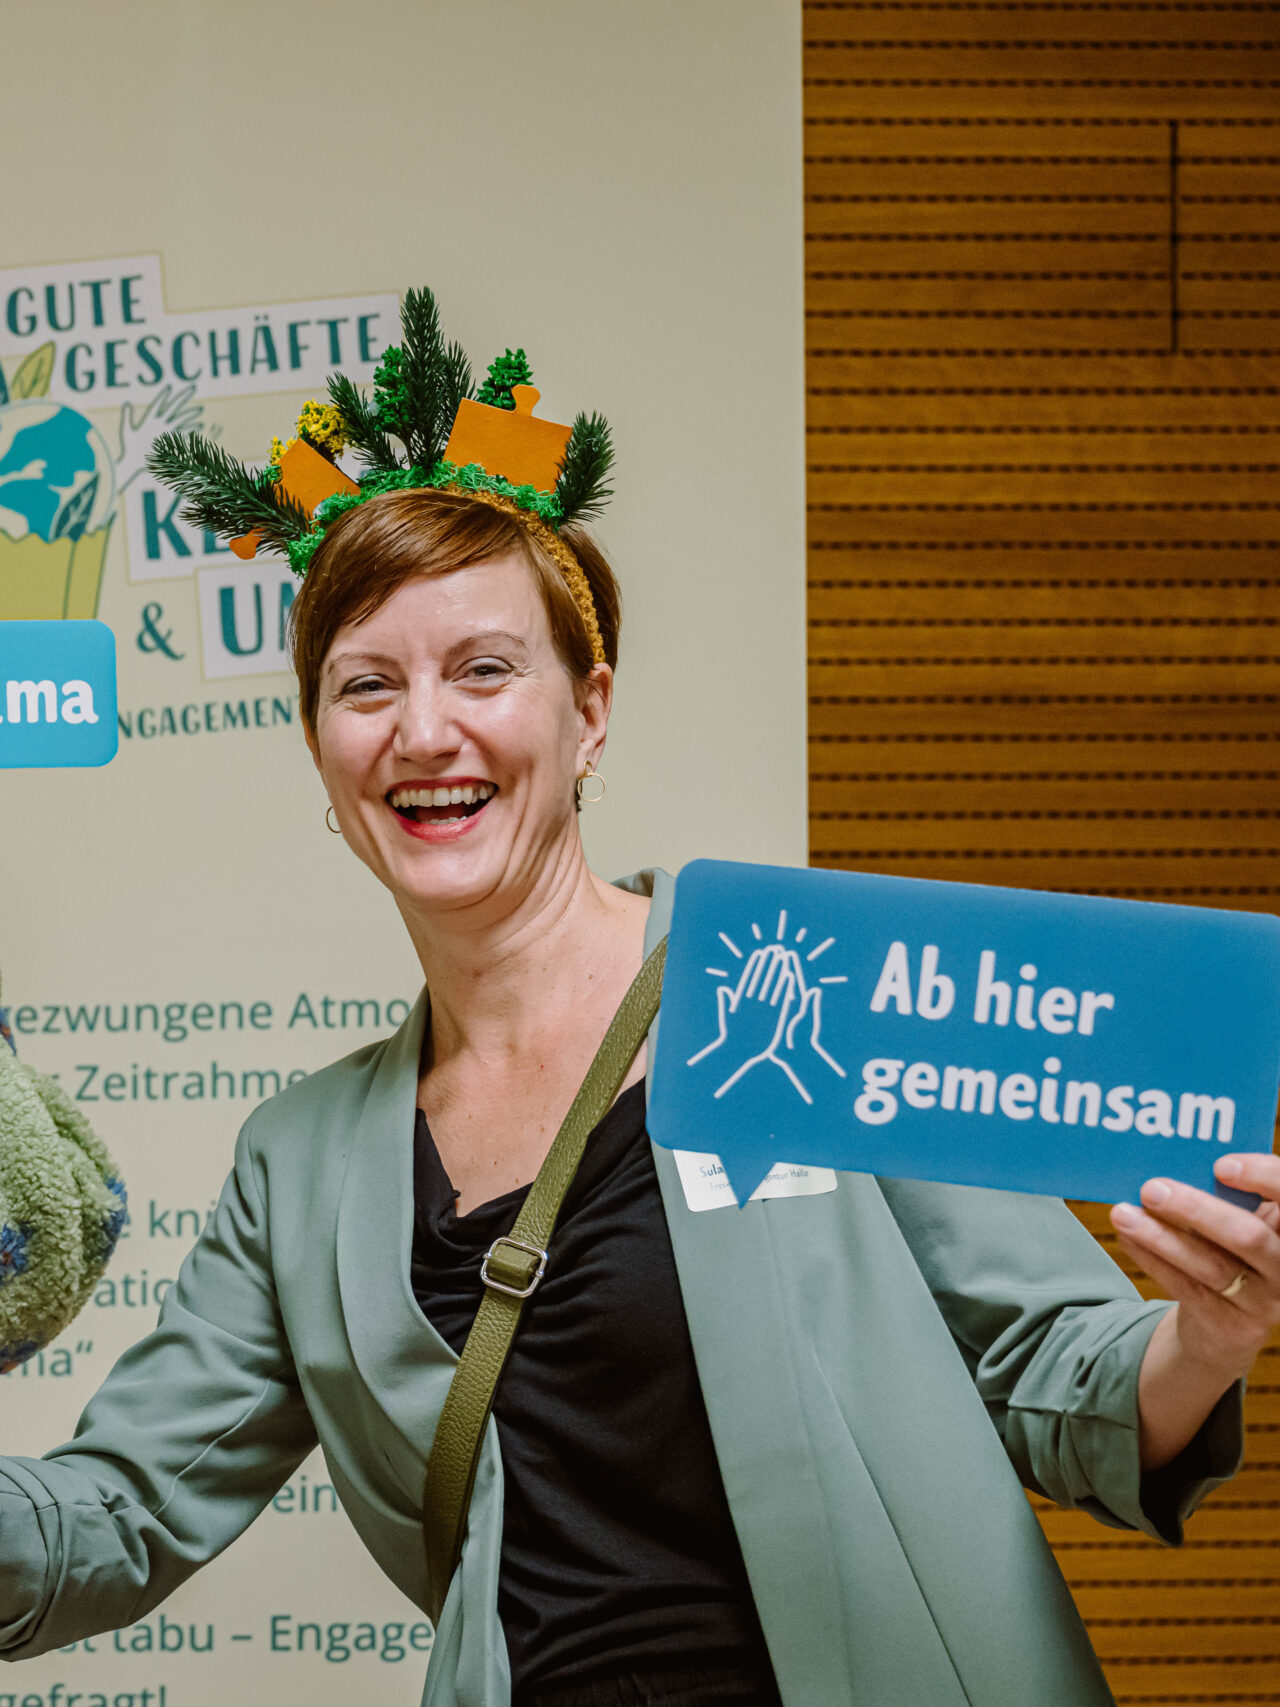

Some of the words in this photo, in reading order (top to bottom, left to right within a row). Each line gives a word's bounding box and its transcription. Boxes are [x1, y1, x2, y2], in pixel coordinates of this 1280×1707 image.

[5, 274, 147, 338] GUTE
[64, 312, 382, 394] GESCHÄFTE
[136, 601, 185, 661] &
[1, 1002, 274, 1043] ezwungene
[869, 941, 956, 1021] Ab
[973, 949, 1116, 1035] hier
[853, 1056, 1237, 1143] gemeinsam
